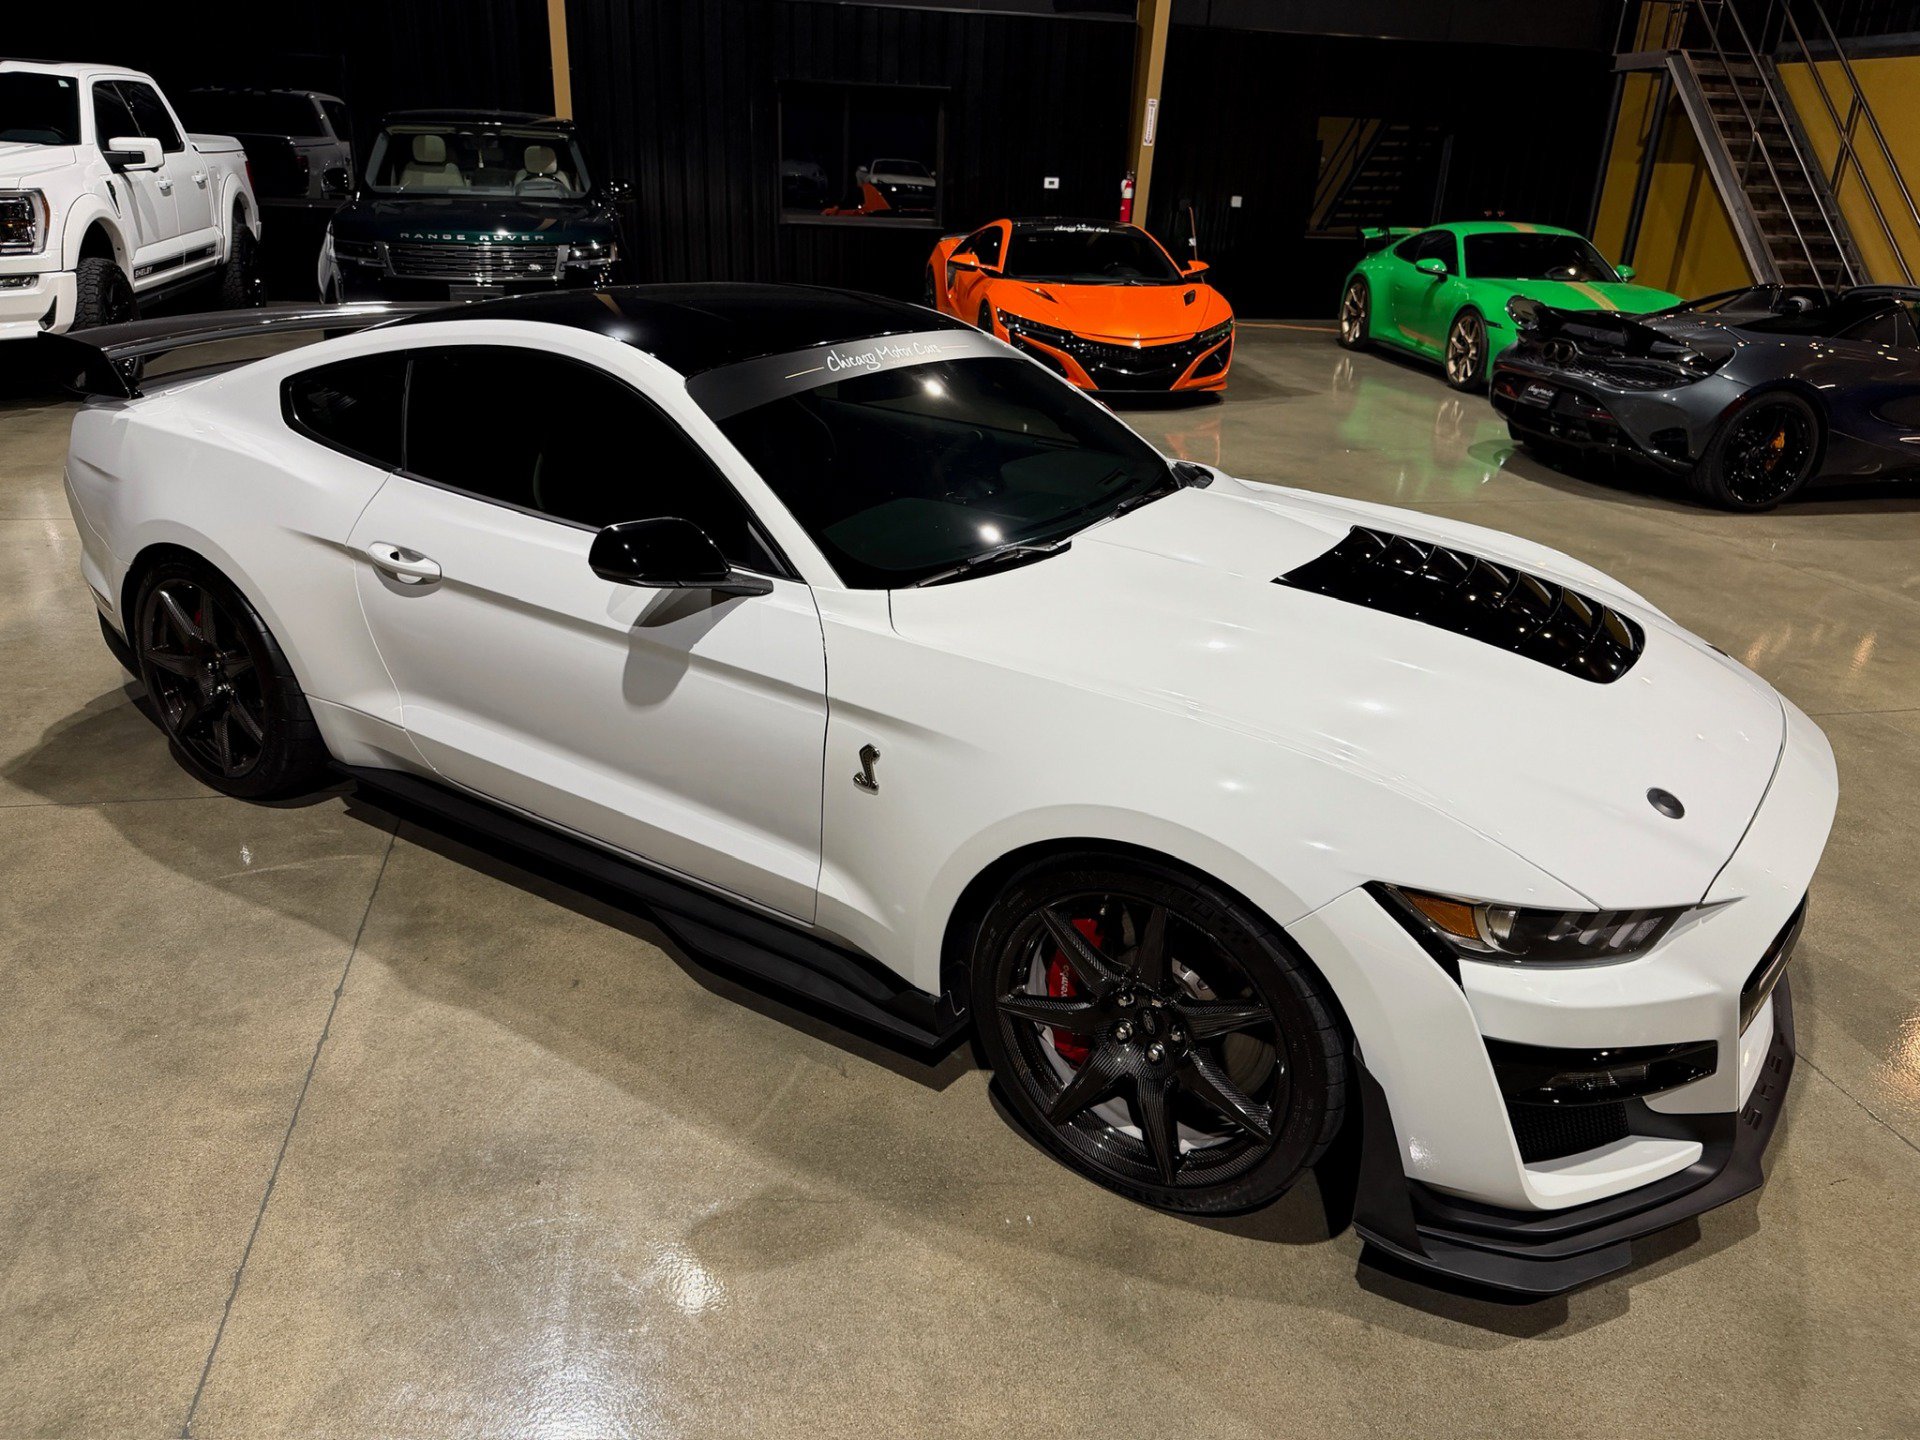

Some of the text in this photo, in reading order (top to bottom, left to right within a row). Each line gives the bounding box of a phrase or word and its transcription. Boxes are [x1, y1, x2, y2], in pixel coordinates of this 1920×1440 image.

[400, 233, 545, 242] RANGE ROVER
[874, 345, 915, 360] Motor
[913, 341, 942, 356] Cars
[1059, 964, 1070, 997] rembo
